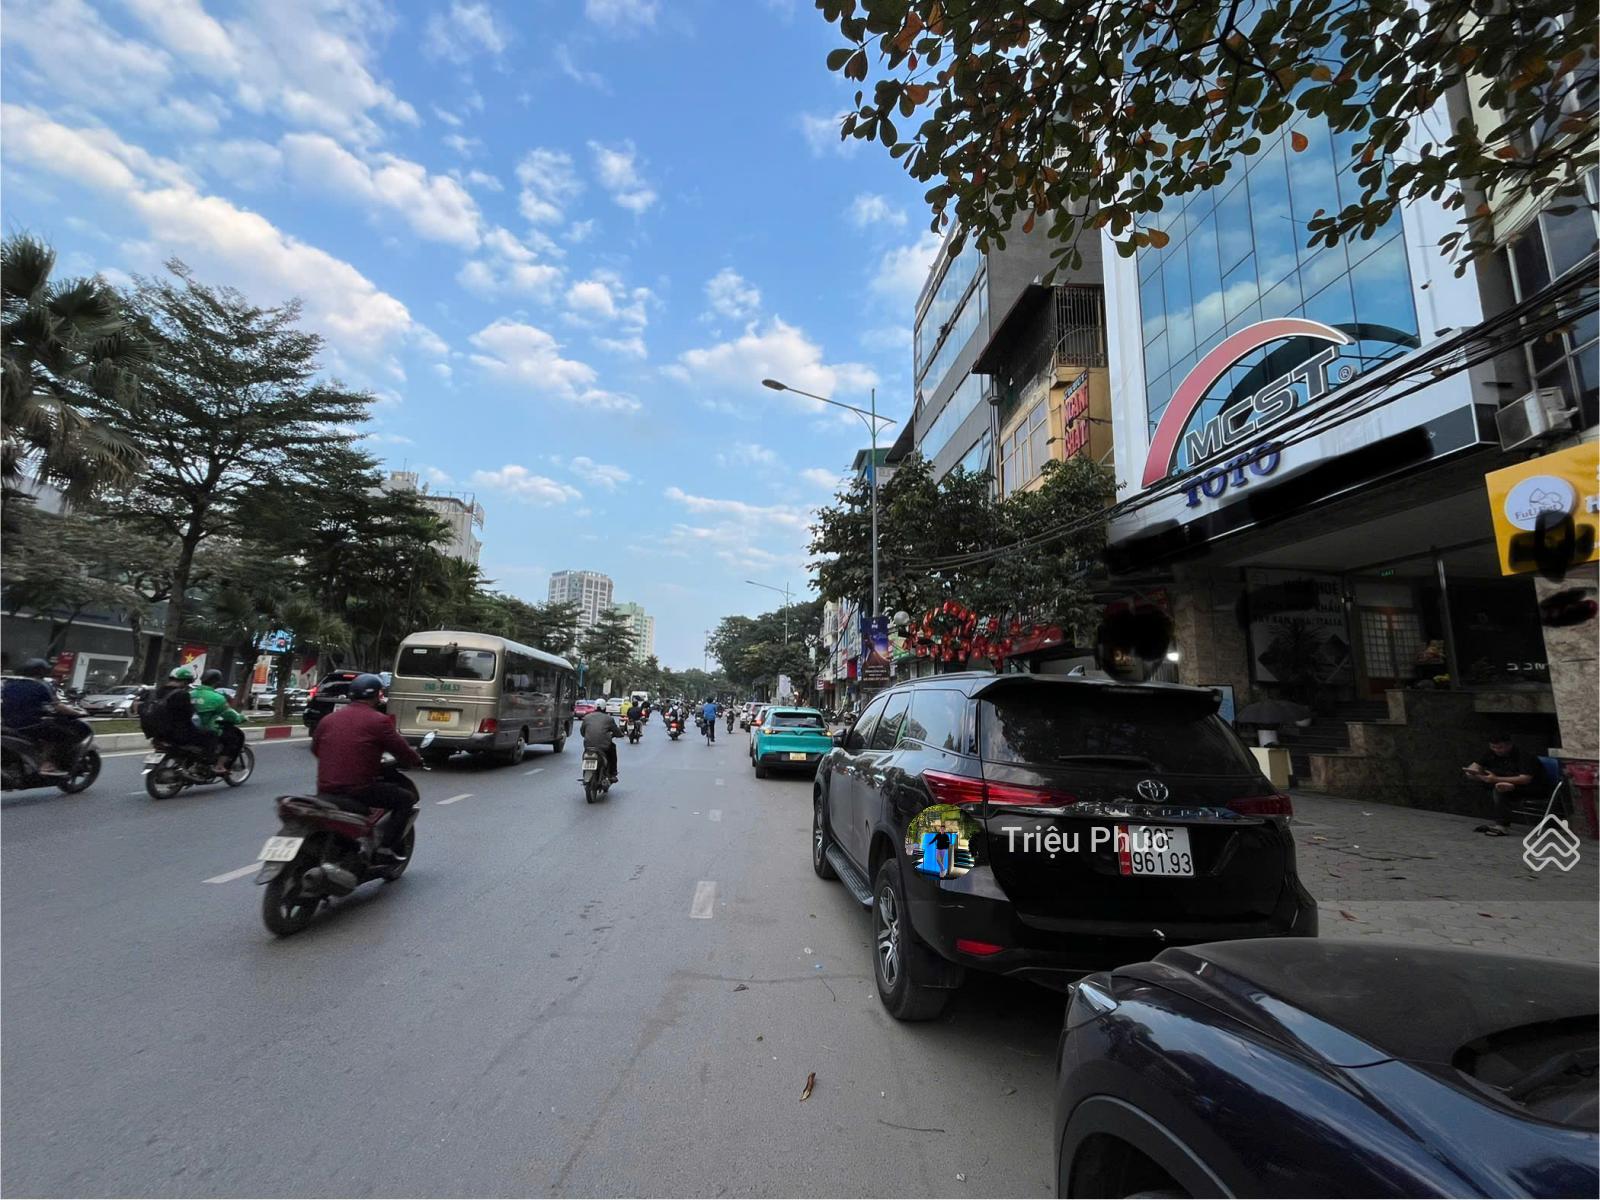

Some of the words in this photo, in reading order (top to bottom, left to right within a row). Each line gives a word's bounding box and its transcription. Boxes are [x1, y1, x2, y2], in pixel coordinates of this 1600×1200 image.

[1184, 345, 1341, 467] MCST
[1181, 442, 1282, 507] TOTO
[1133, 852, 1192, 874] 961.93
